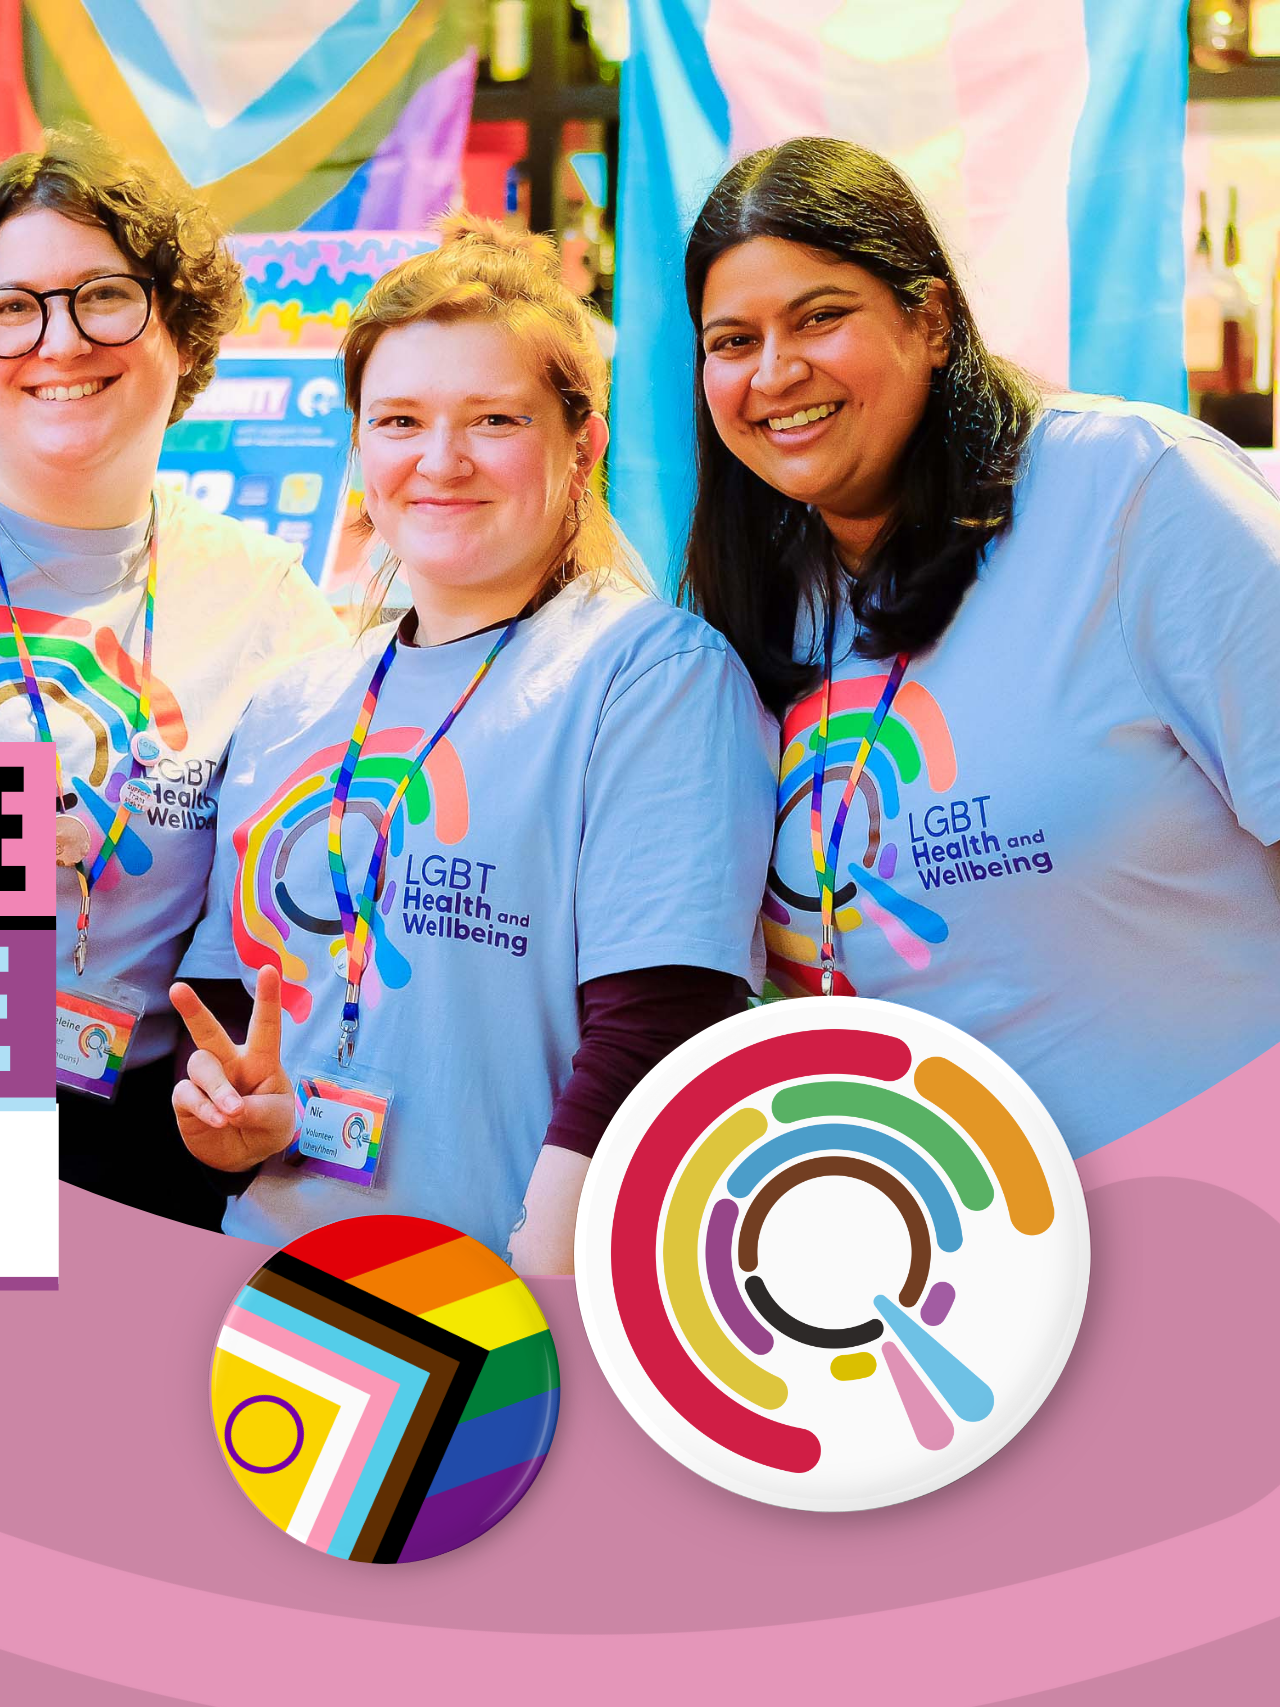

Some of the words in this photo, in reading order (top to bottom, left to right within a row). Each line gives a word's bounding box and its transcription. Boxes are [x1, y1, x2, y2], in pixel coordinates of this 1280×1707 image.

[909, 795, 991, 843] LGBT
[912, 831, 1001, 867] Health
[1007, 829, 1045, 849] and
[405, 854, 497, 894] LGBT
[918, 851, 1053, 891] Wellbeing
[403, 887, 492, 920] Health
[497, 912, 530, 928] and
[402, 912, 528, 957] Wellbeing
[309, 1106, 323, 1119] Nic
[305, 1127, 334, 1142] Volunteer
